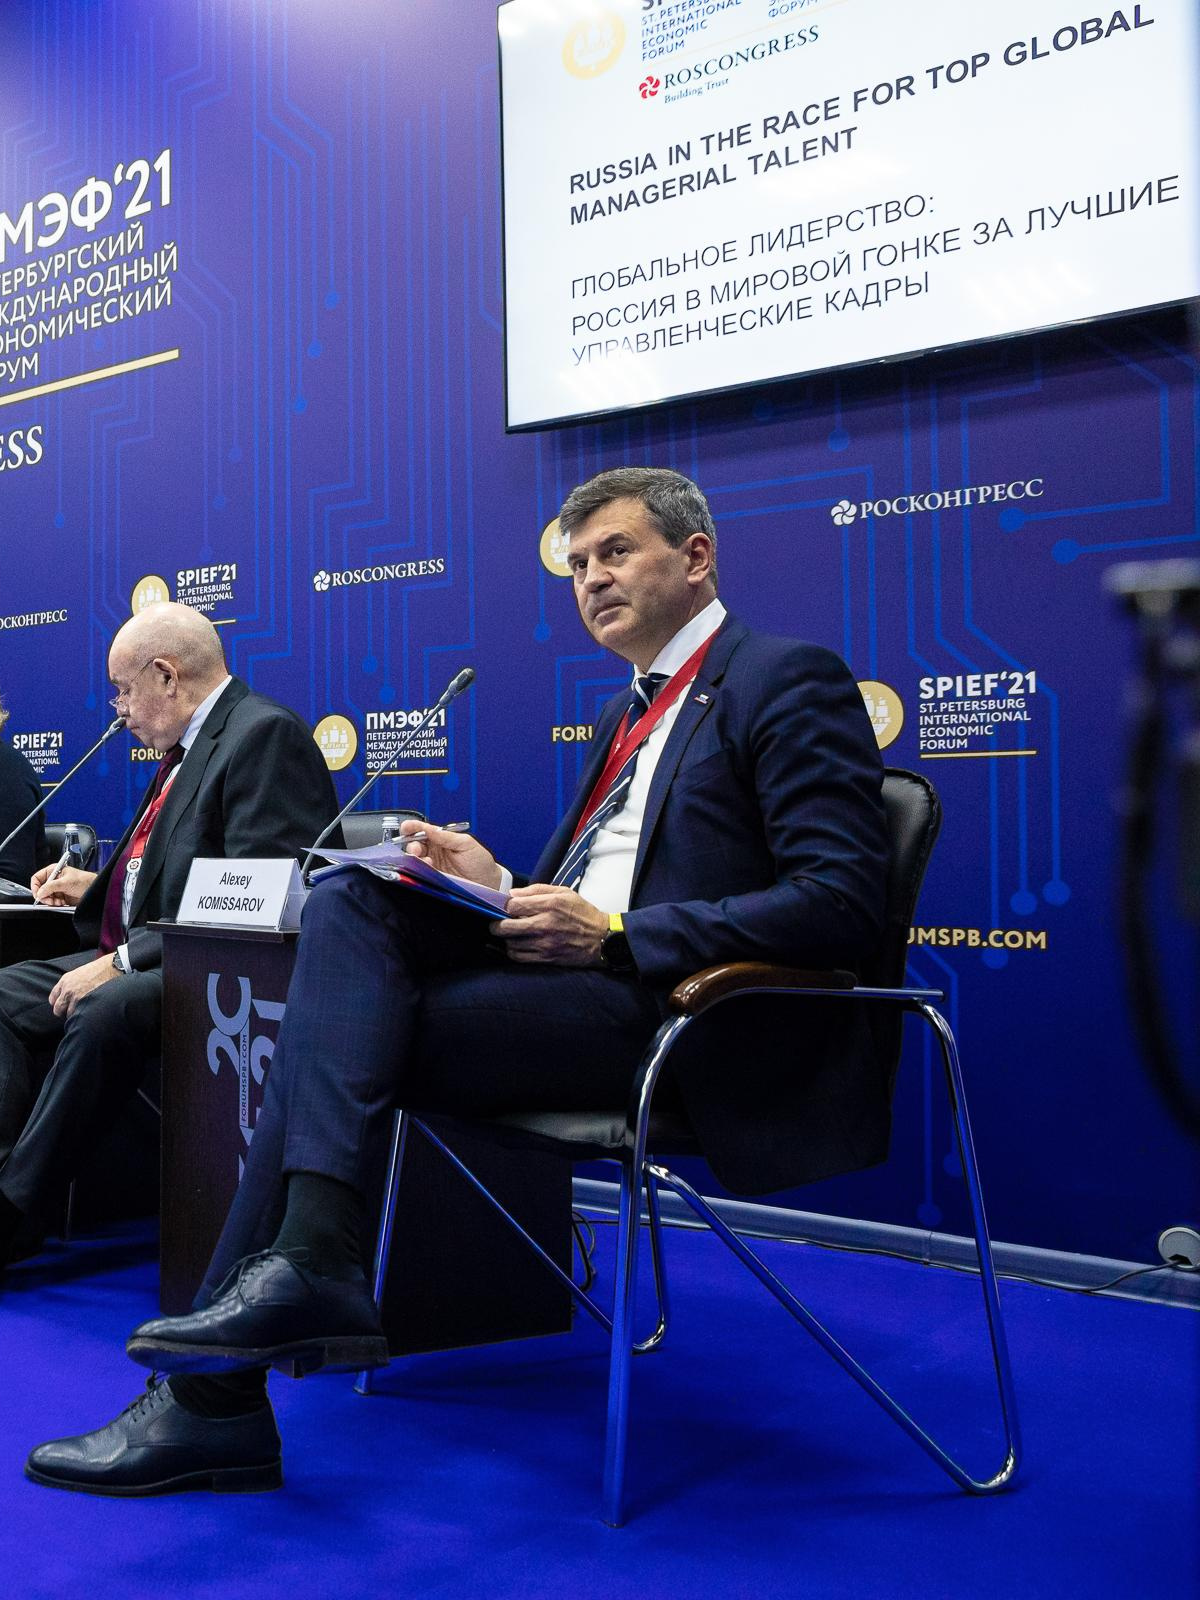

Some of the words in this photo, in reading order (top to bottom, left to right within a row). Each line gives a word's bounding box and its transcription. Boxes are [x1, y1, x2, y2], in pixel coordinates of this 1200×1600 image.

[642, 19, 708, 49] ECONOMIC
[642, 40, 685, 61] FORUM
[664, 25, 819, 90] ROSCONGRESS
[569, 152, 657, 194] RUSSIA
[667, 143, 691, 166] IN
[700, 124, 752, 158] THE
[762, 97, 841, 140] RACE
[853, 75, 916, 113] FOR
[926, 52, 991, 91] TOP
[1002, 4, 1155, 67] GLOBAL
[664, 85, 703, 103] Building
[705, 78, 729, 91] Trust
[570, 164, 737, 226] MANAGERIAL
[748, 127, 859, 176] TALENT
[571, 243, 738, 299] ГЛОБАЛЬНОЕ
[747, 194, 934, 259] ЛИДЕРСТВО:
[571, 295, 676, 337] РОССИЯ
[686, 288, 702, 311] В
[711, 251, 852, 306] МИРОВОЙ
[862, 229, 962, 274] ГОНКЕ
[973, 217, 1014, 247] ЗА
[1024, 174, 1180, 237] ЛУЧШИЕ
[571, 297, 814, 366] УПРАВЛЕНЧЕСКИЕ
[824, 271, 930, 315] КАДРЫ
[860, 478, 1044, 519] РОСКОНГРЕСС
[177, 563, 237, 587] SPIEF'21
[332, 558, 445, 587] ROSCONGRESS
[177, 589, 187, 598] ST.
[188, 583, 231, 596] PETERSBURG
[177, 592, 234, 605] INTERNATIONAL
[919, 671, 1037, 700] SPIEF'21
[920, 703, 938, 713] ST.
[940, 698, 1026, 713] PETERSBURG
[920, 711, 1032, 725] INTERNATIONAL
[13, 731, 63, 750] SPIEF'21
[920, 725, 994, 738] ECONOMIC
[366, 737, 448, 751] МЕЖДУНРОДНЫЙ
[920, 739, 968, 750] FORUM
[219, 872, 253, 890] Alexey
[197, 895, 265, 912] KOMISSAROV
